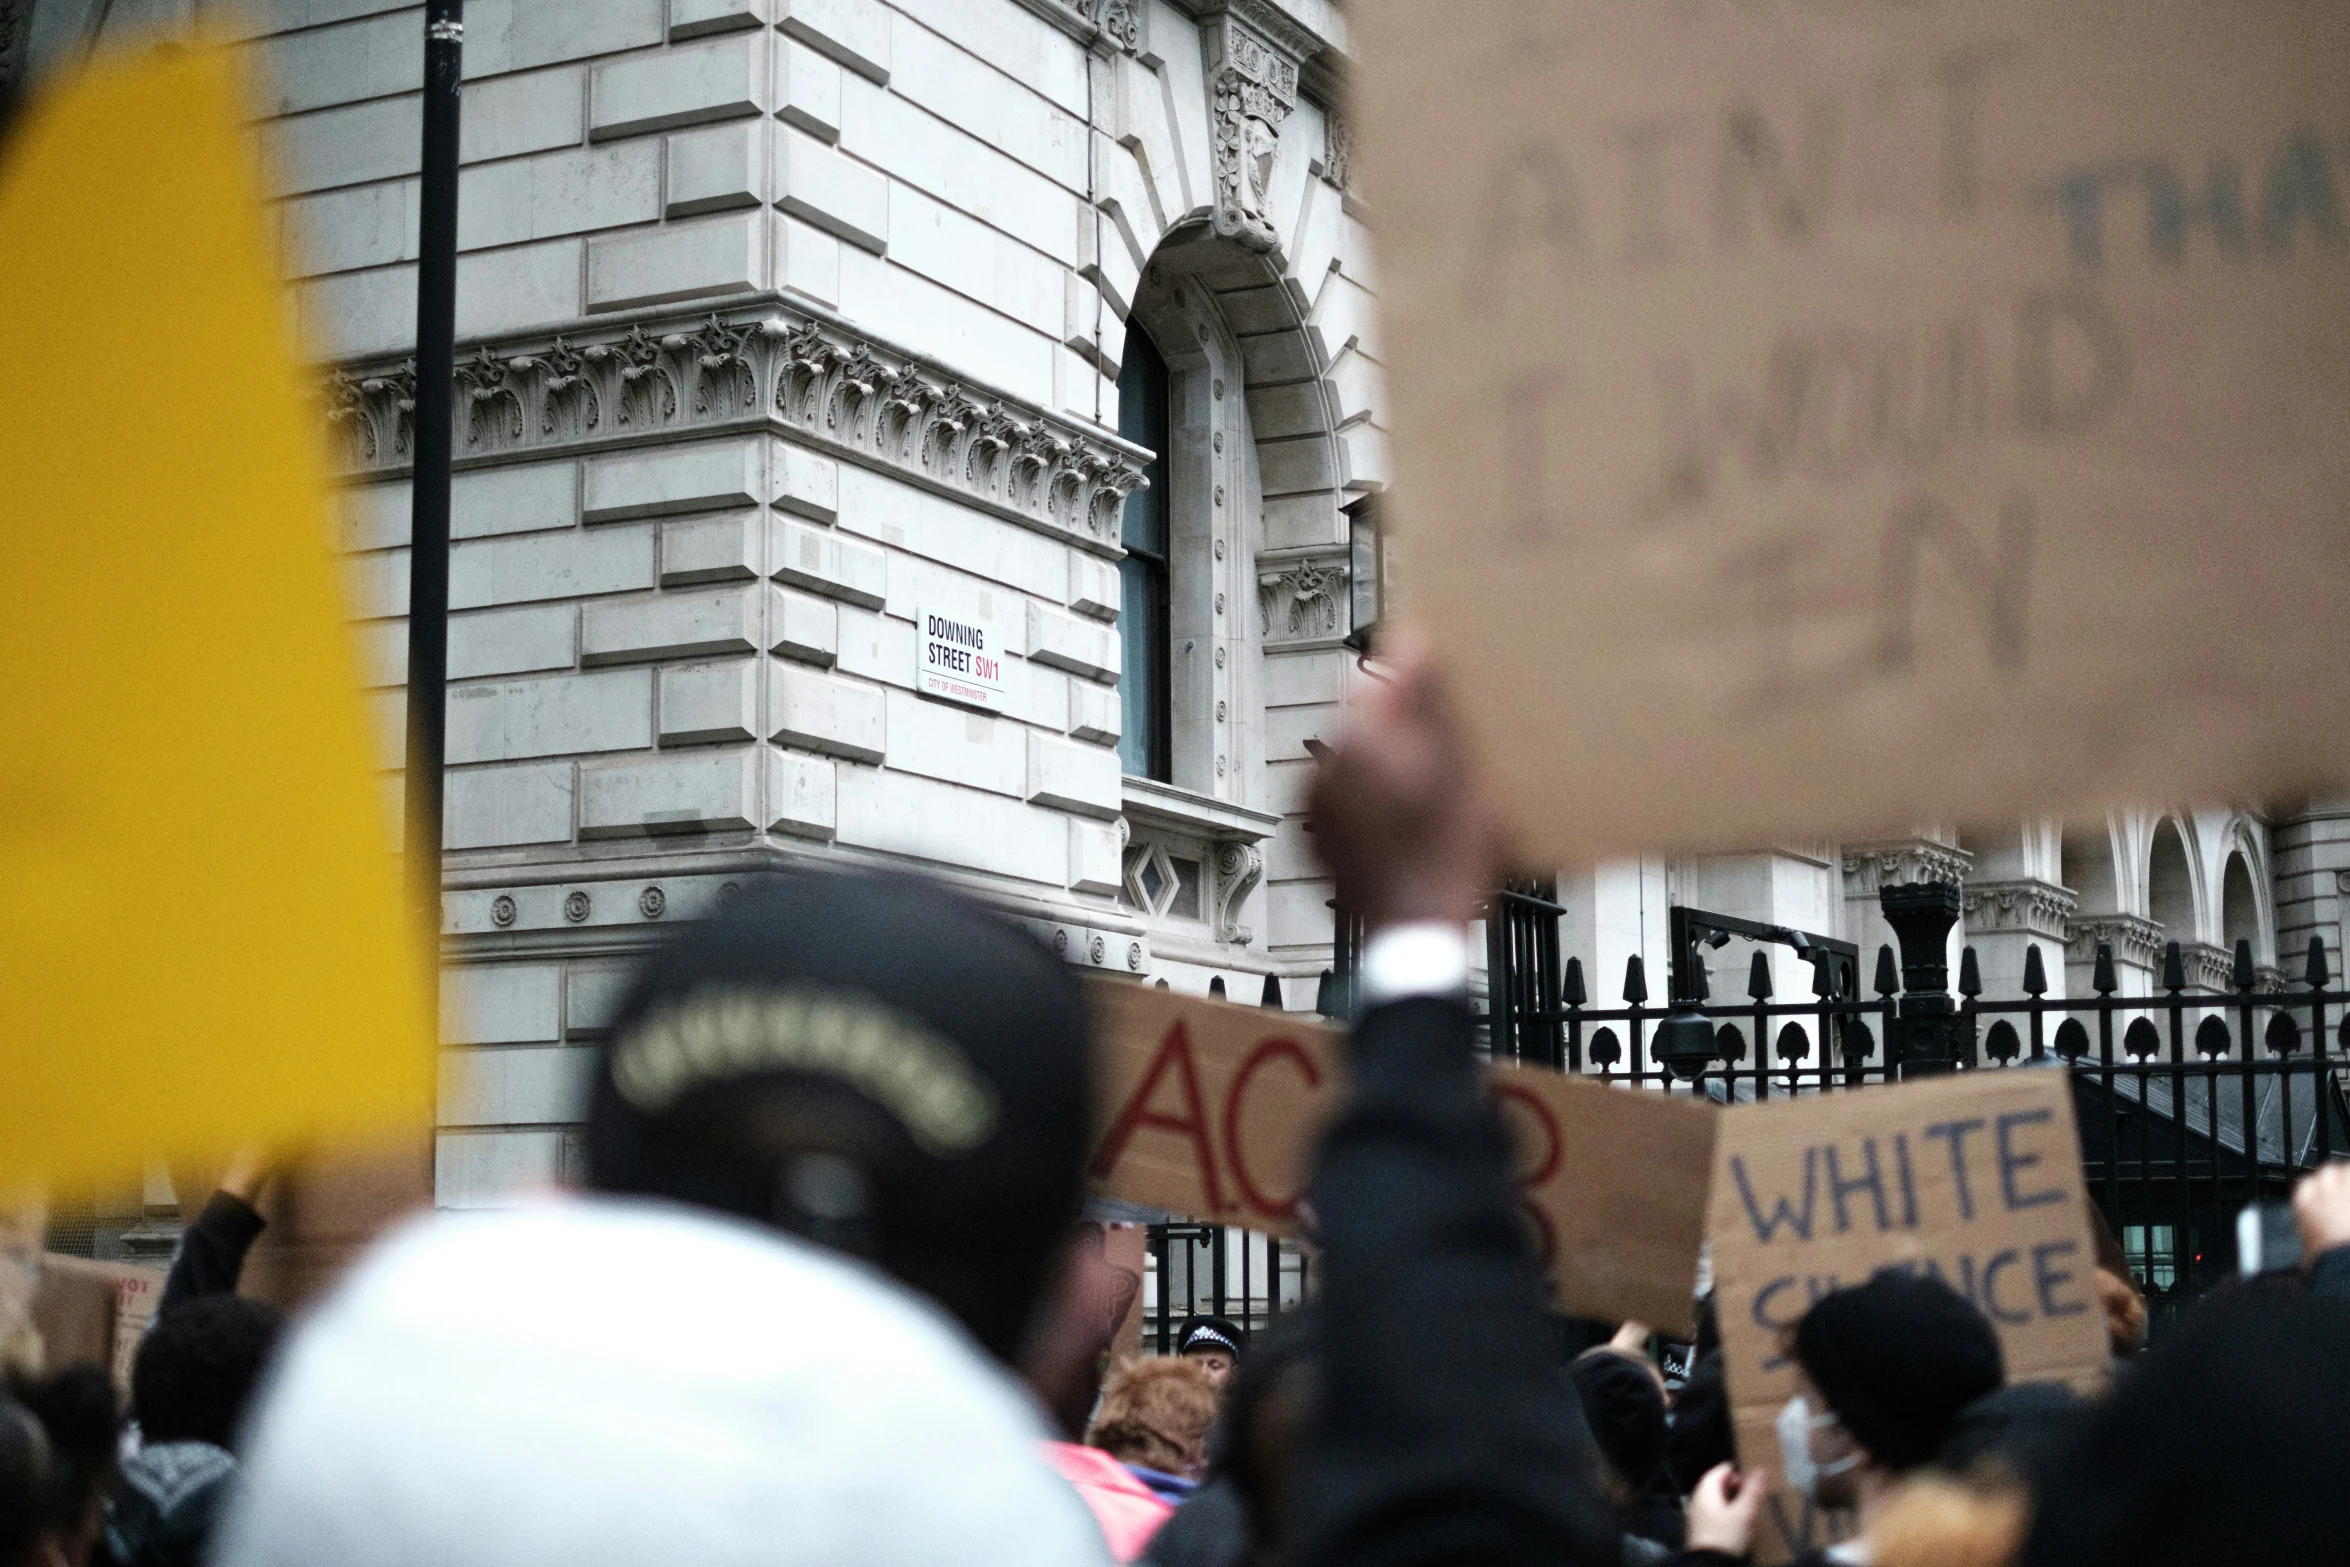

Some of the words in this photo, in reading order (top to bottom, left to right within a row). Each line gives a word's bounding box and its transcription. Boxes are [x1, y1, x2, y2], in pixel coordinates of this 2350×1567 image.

[928, 614, 983, 649] DOWNING
[928, 642, 971, 673] STREET
[975, 655, 998, 681] SW1
[928, 677, 941, 688] CITY
[942, 681, 949, 692] OF
[950, 684, 986, 701] WESTMINSTER
[1730, 1107, 2068, 1243] WHITE
